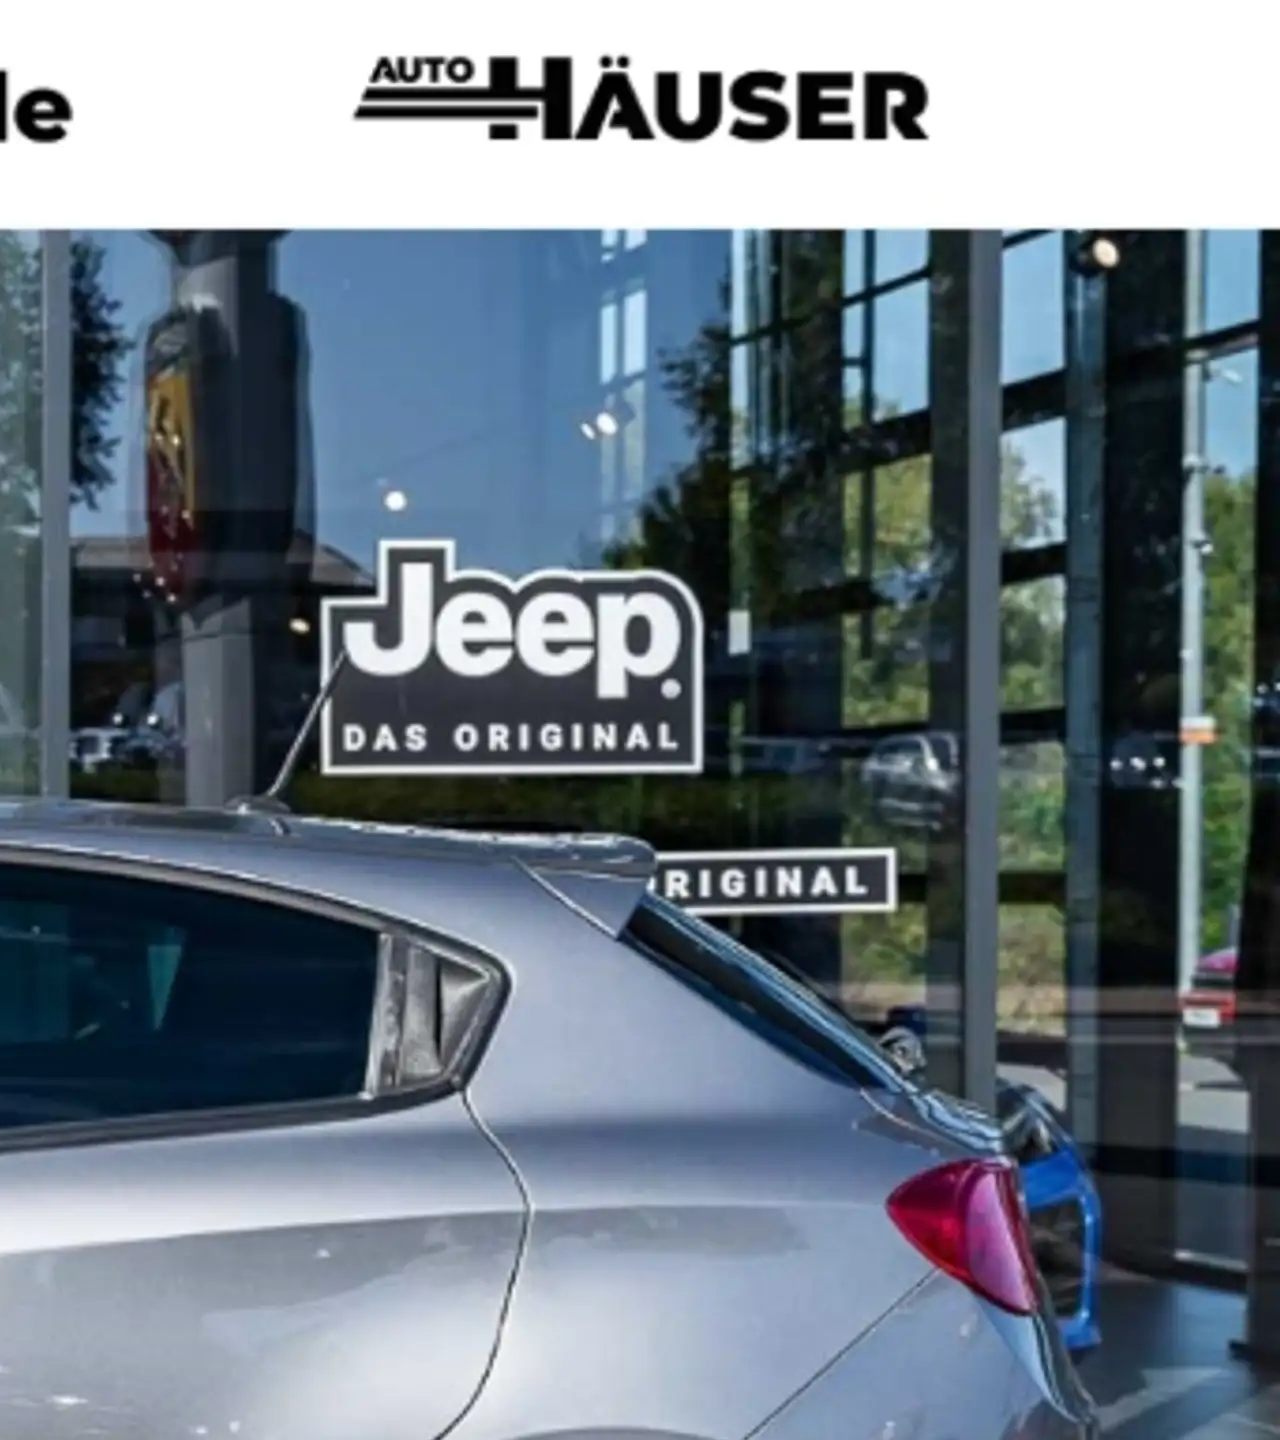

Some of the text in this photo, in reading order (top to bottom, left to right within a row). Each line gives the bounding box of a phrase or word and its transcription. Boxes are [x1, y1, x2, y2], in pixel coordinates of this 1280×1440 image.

[343, 561, 682, 699] Jeep
[343, 723, 679, 752] DAS ORIGINAL
[647, 864, 868, 898] RIGINAL
